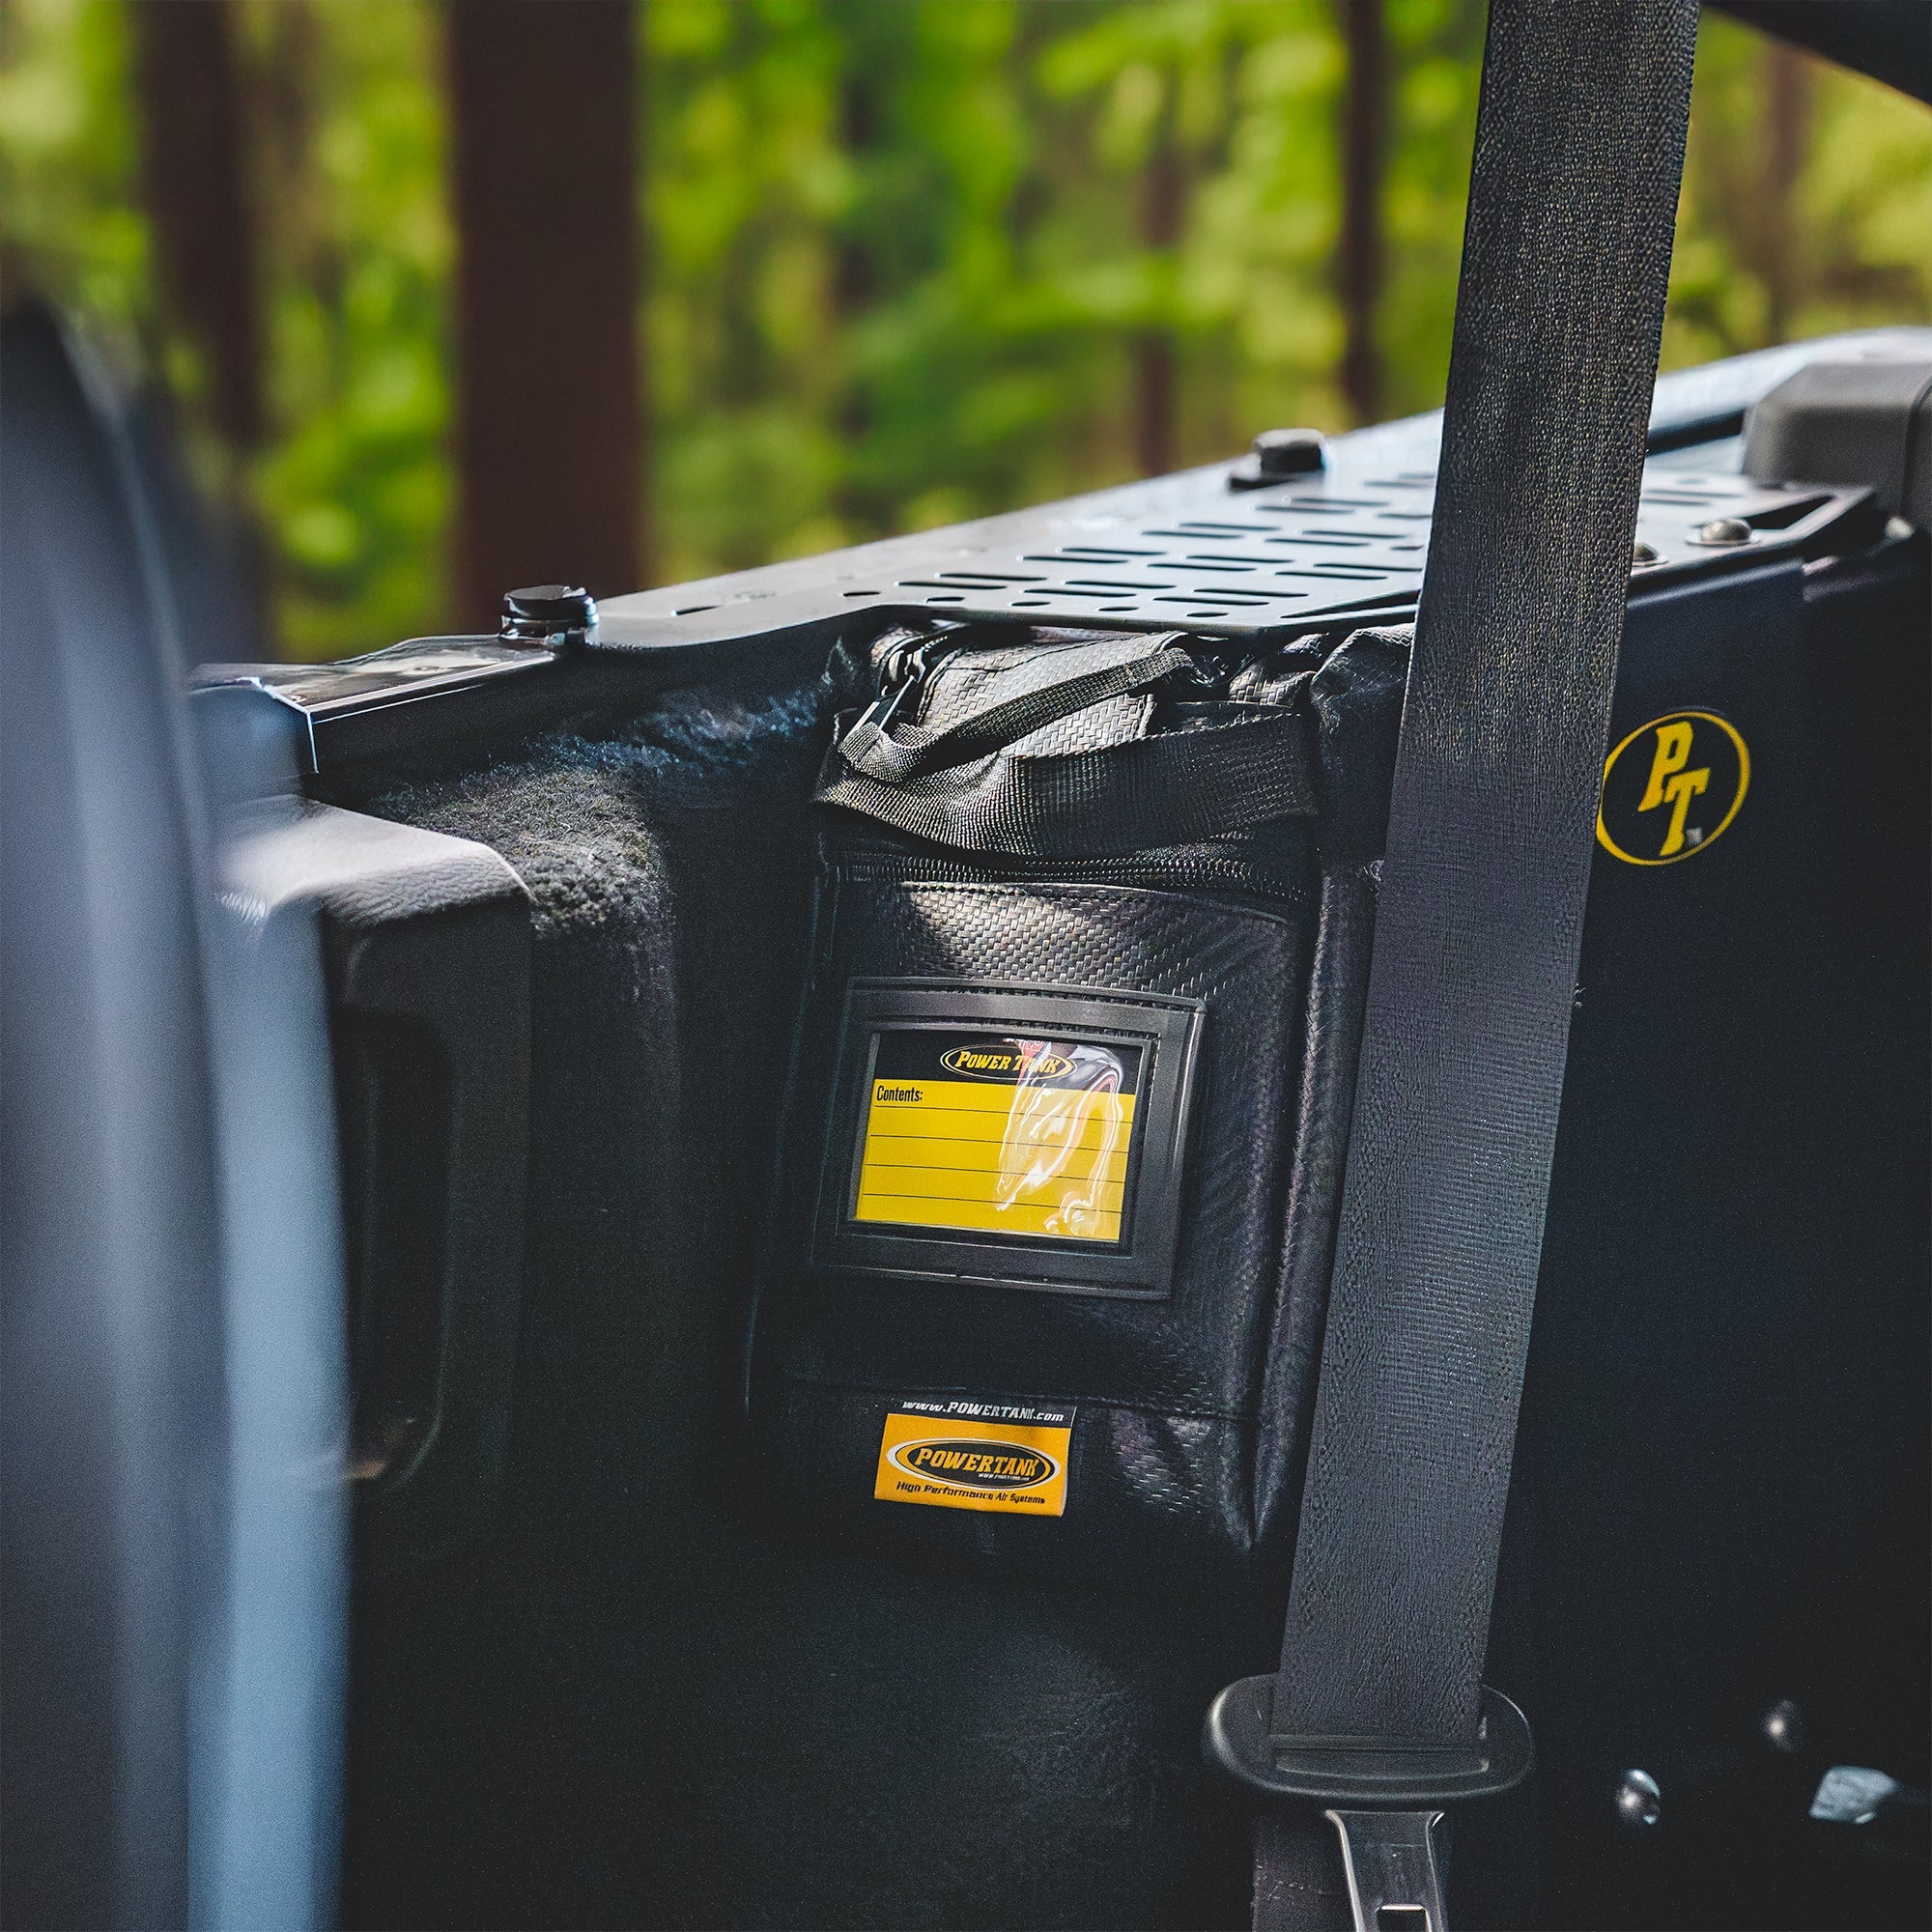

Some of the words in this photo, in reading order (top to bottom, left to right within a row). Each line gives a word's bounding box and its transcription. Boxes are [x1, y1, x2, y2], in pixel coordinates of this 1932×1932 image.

[954, 1051, 1012, 1070] POWER
[876, 1085, 923, 1102] Contents:
[915, 1448, 1040, 1477] POWERTANK
[895, 1481, 921, 1493] High
[923, 1485, 994, 1500] Performance
[996, 1492, 1008, 1501] Air
[1010, 1492, 1045, 1504] Systems
